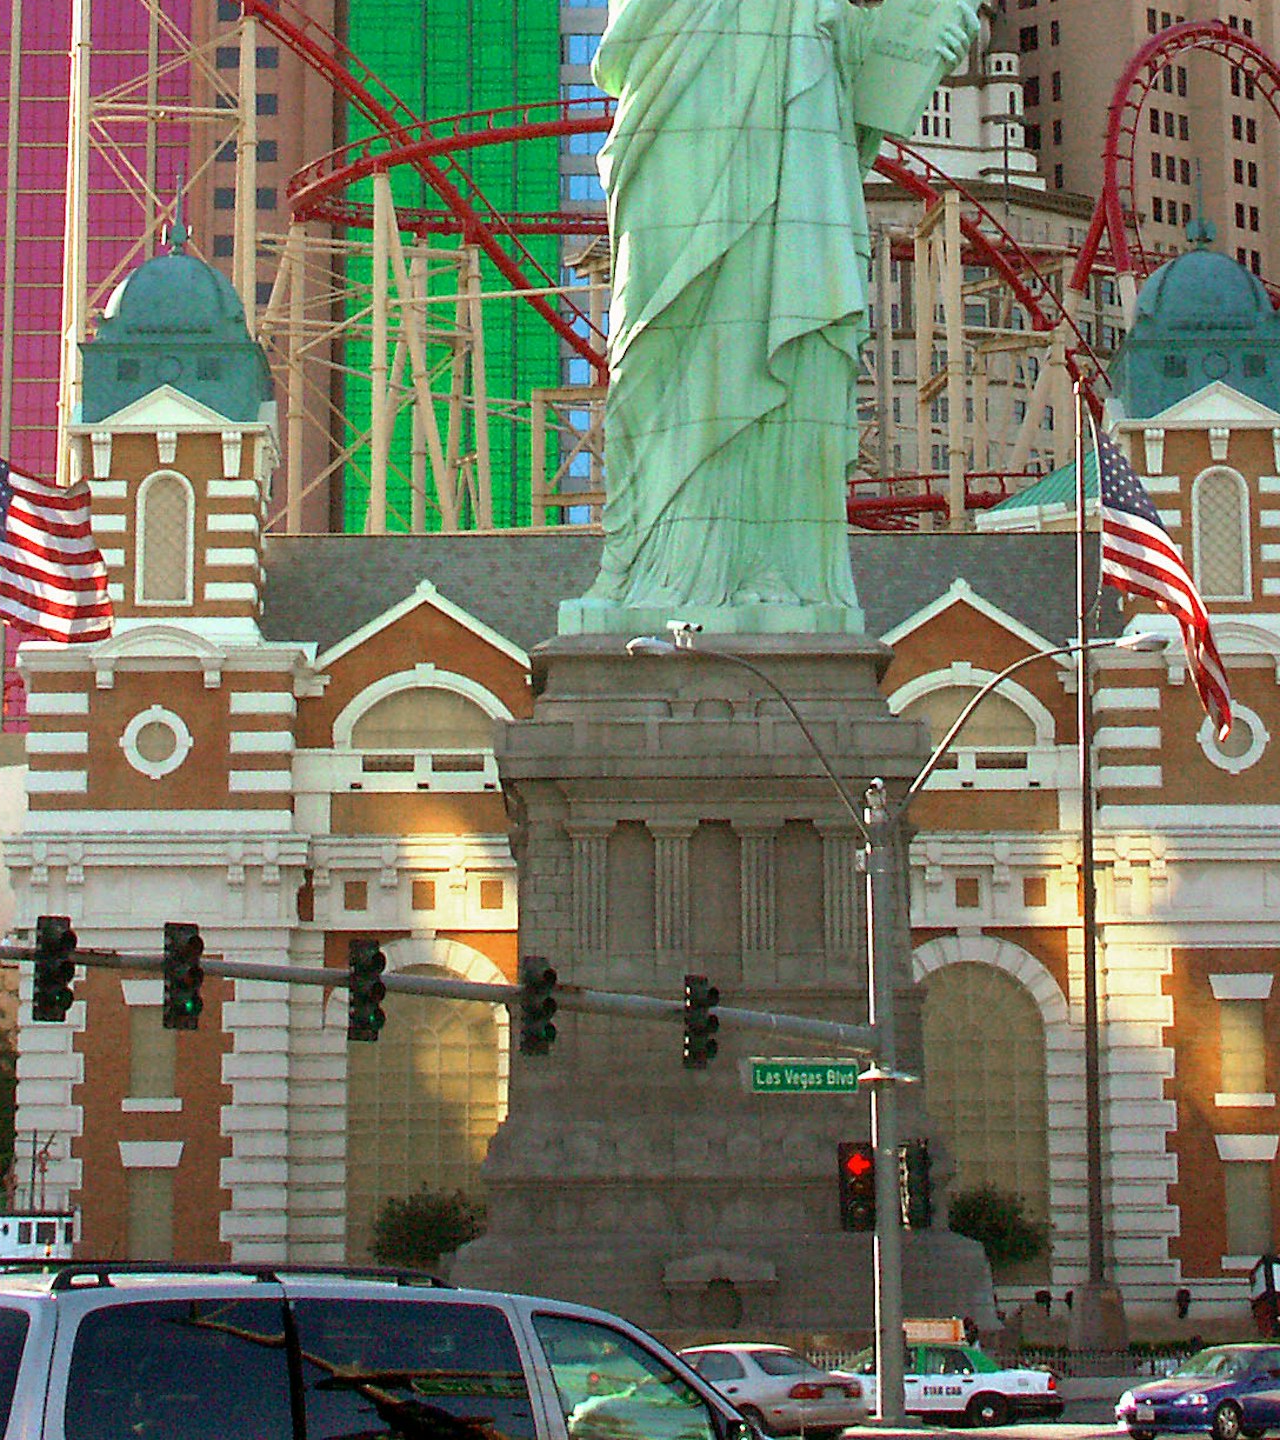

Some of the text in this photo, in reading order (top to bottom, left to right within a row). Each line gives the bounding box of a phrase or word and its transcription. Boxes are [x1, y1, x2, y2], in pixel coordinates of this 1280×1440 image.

[756, 1069, 854, 1089] Las Vegas Blvd
[945, 1385, 962, 1396] CAB
